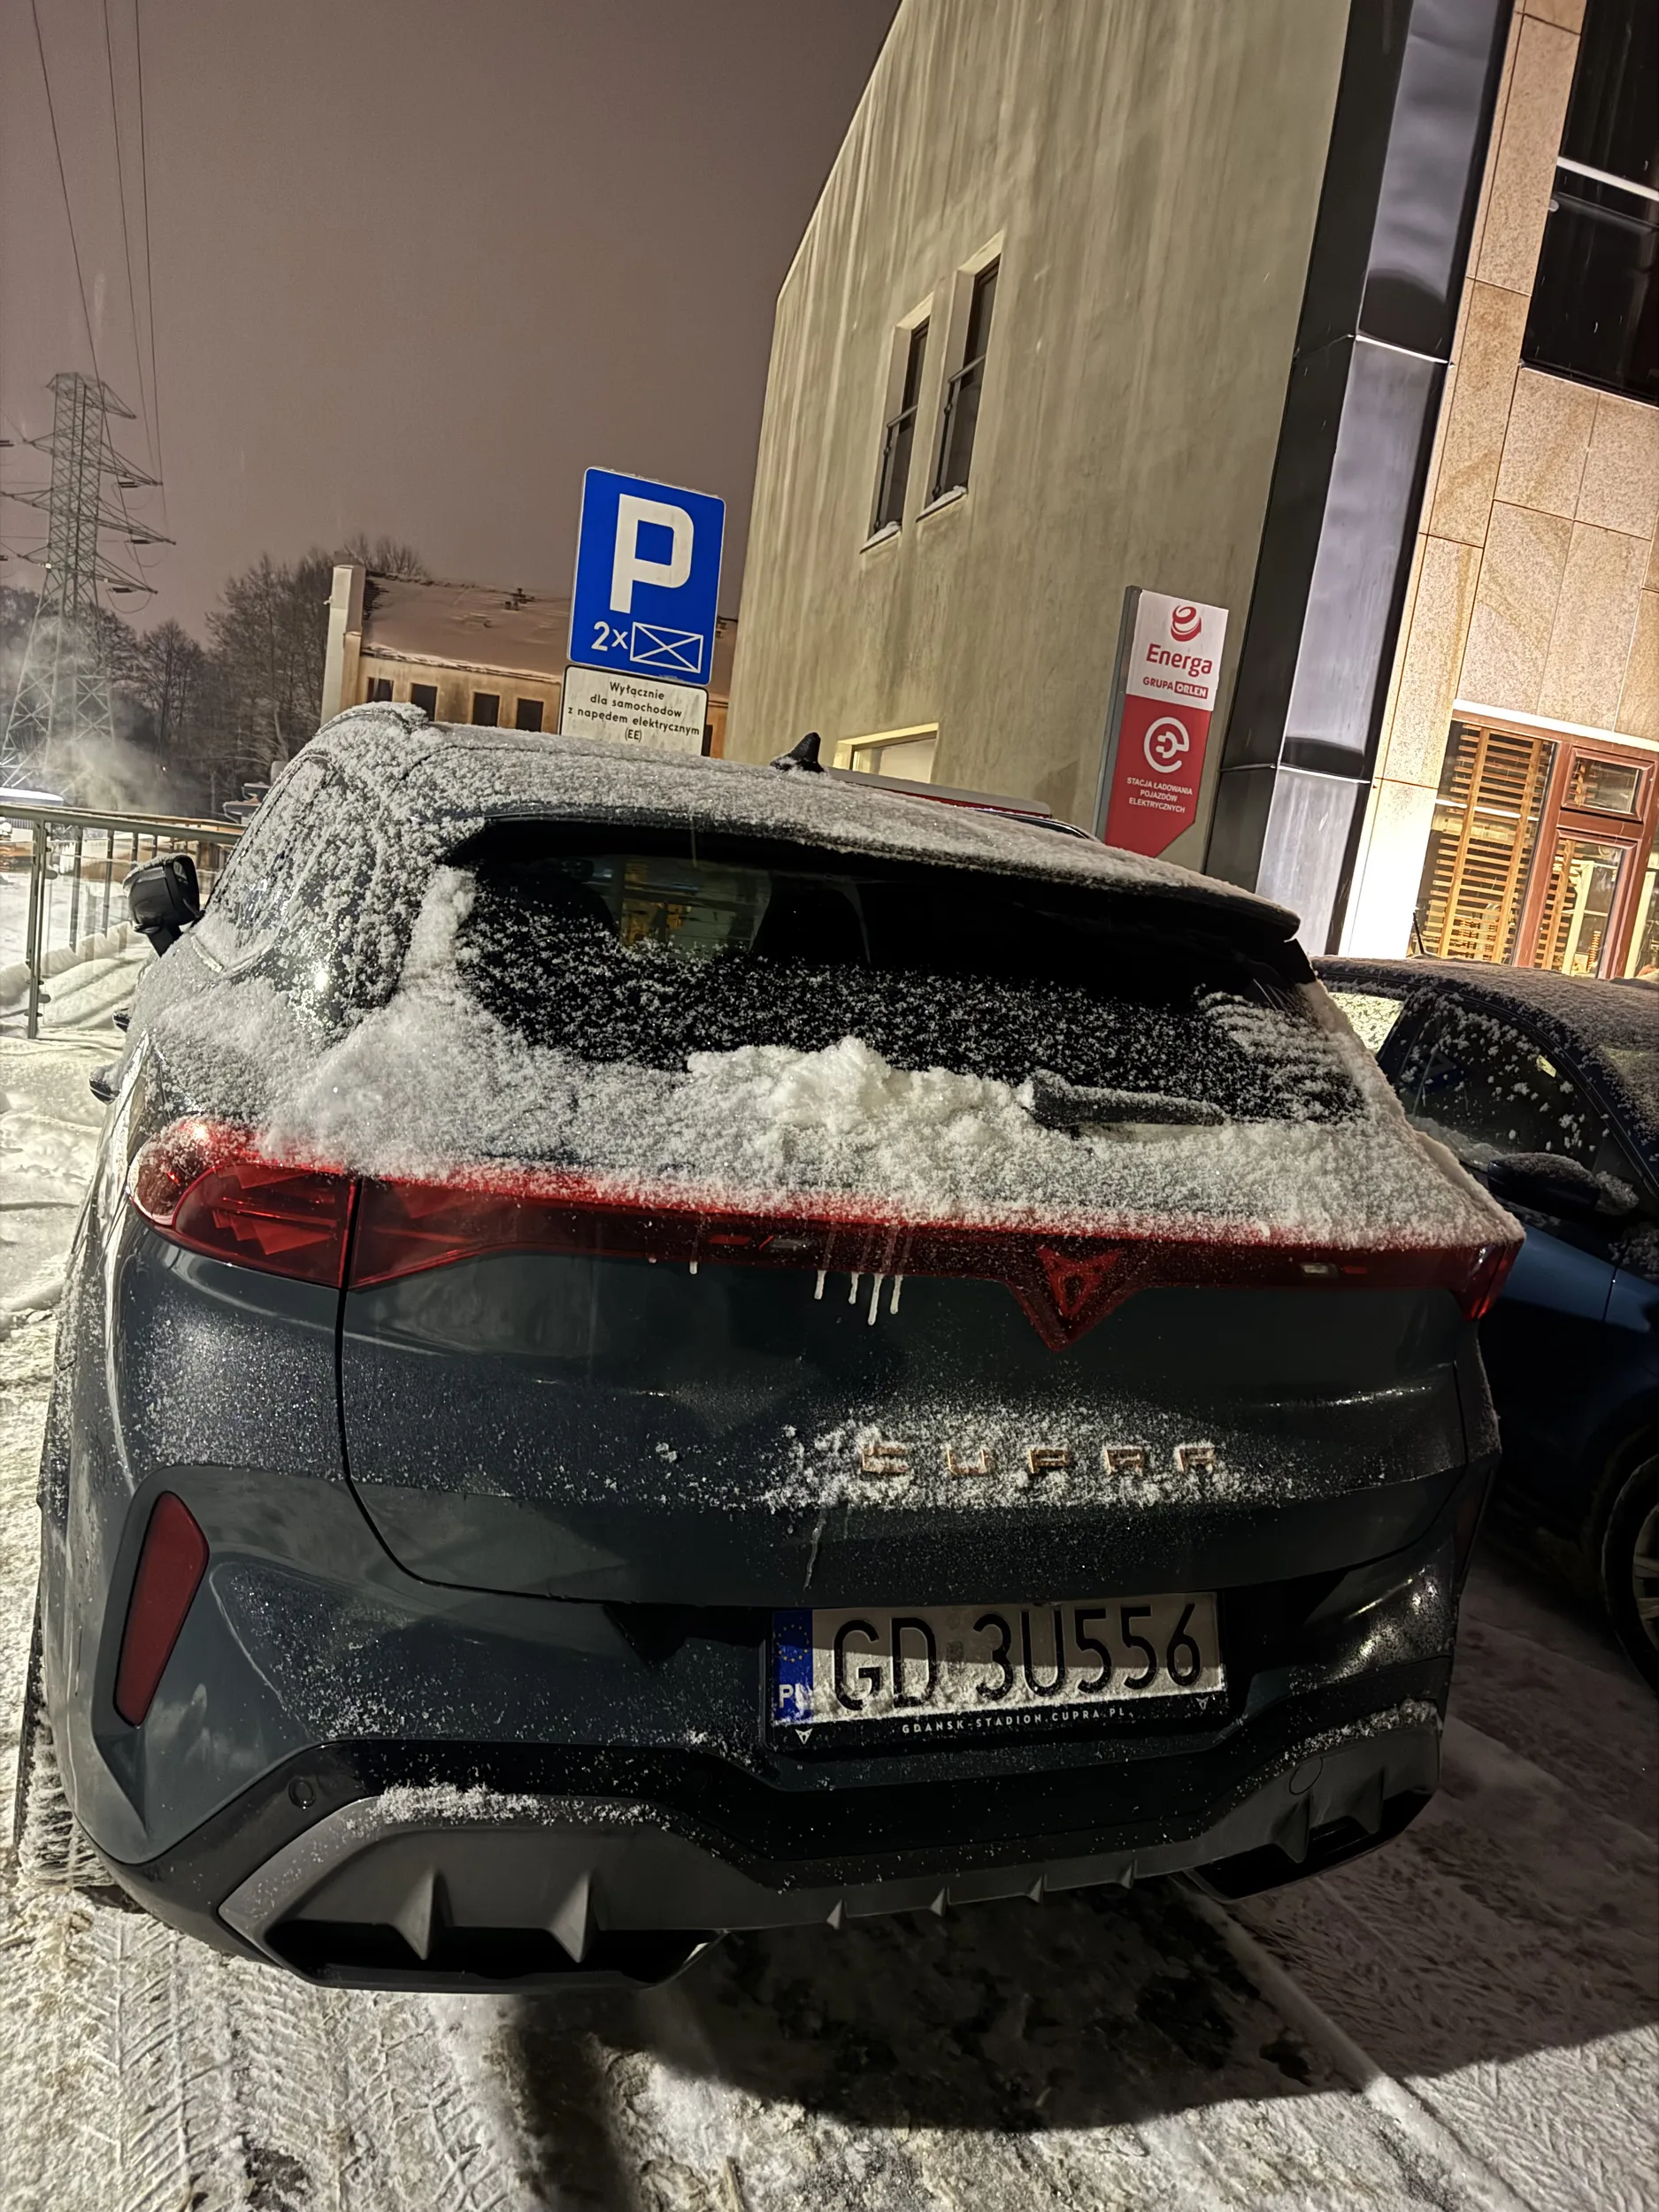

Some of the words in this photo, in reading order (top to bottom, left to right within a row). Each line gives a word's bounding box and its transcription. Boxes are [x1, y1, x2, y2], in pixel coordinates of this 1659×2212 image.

[610, 493, 694, 613] P
[591, 621, 628, 651] 2x
[1146, 643, 1212, 678] Energa
[610, 681, 664, 700] Wyłącznie
[1142, 676, 1173, 690] GRUPA
[1176, 683, 1207, 697] ORLEN
[590, 694, 607, 705] dla
[612, 699, 682, 718] samochodów
[578, 708, 627, 723] napędem
[633, 716, 699, 736] elektrycznym
[625, 727, 642, 742] (EE)
[1126, 777, 1152, 787] STACJA
[1153, 782, 1193, 795] ŁADOWANIA
[1140, 789, 1178, 802] POJAZDÓW
[1129, 797, 1186, 813] ELEKTRYCZNYCH
[861, 1444, 1215, 1476] CUPRA
[833, 1617, 937, 1710] GD
[973, 1602, 1201, 1701] 3U556
